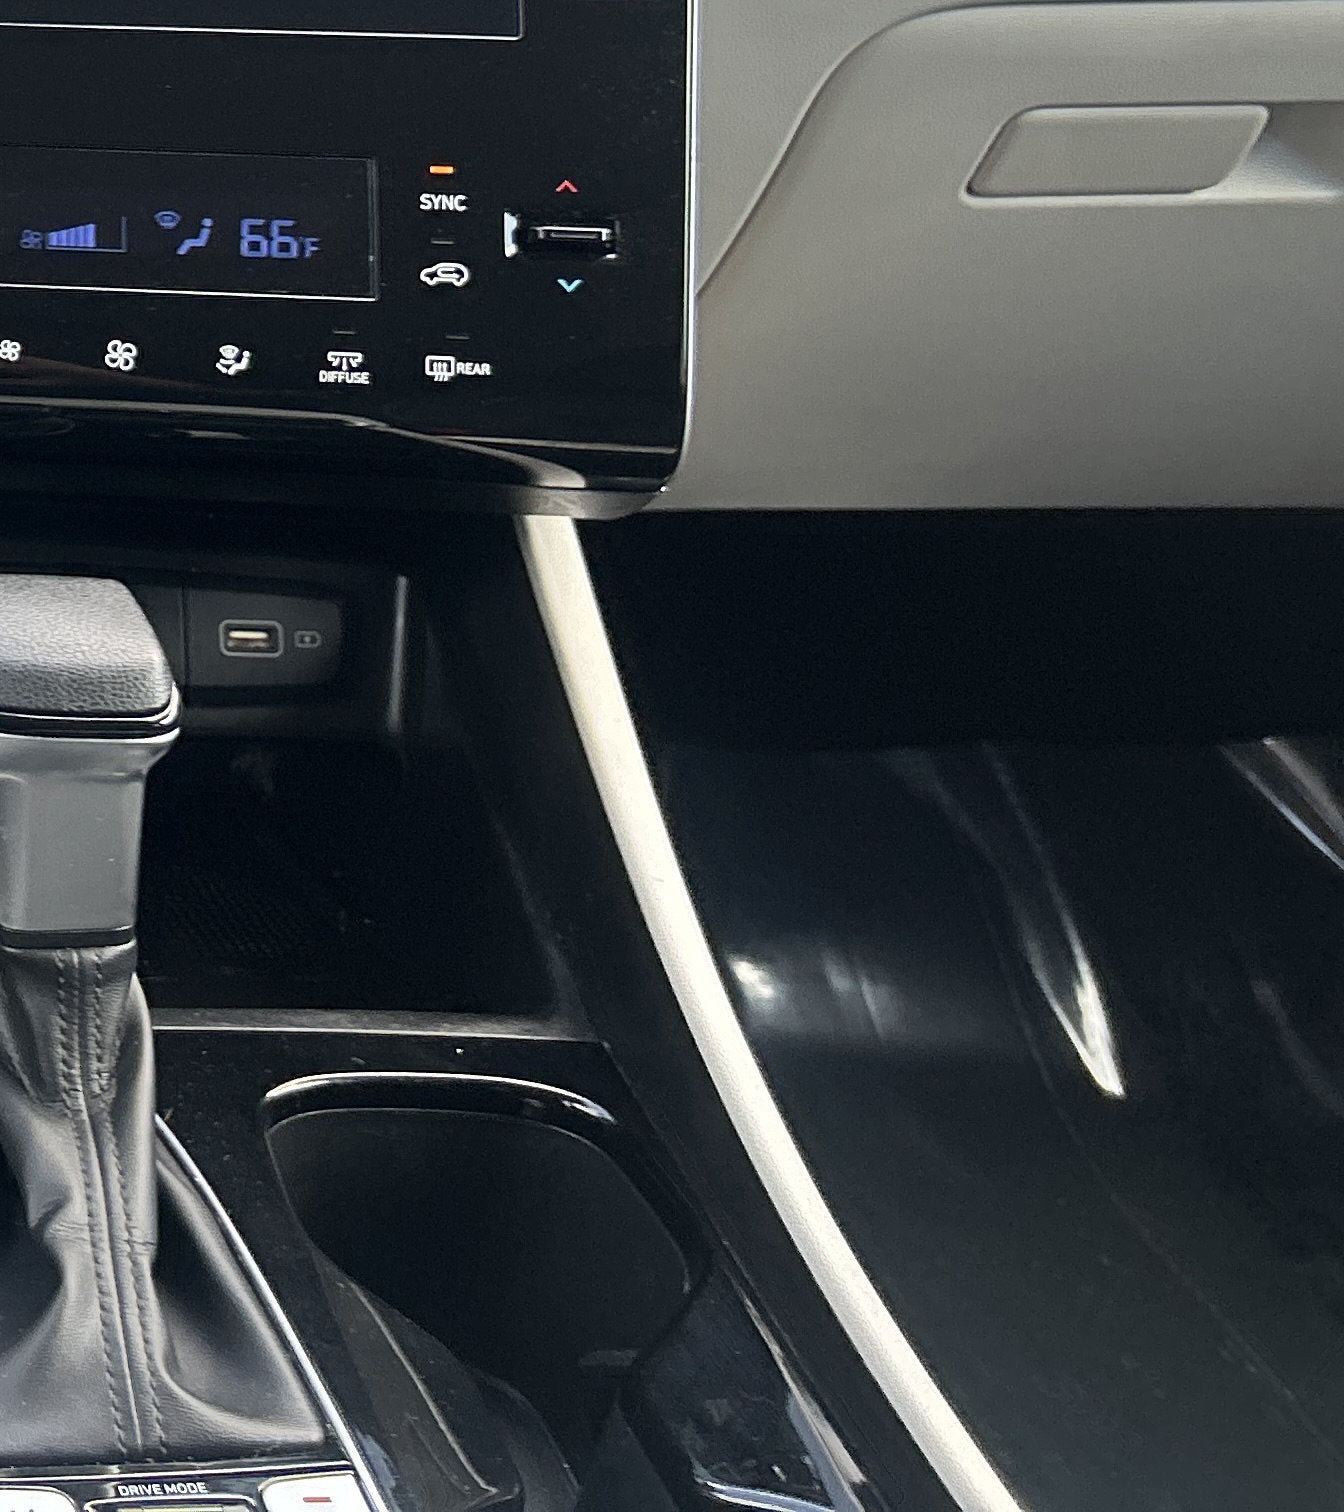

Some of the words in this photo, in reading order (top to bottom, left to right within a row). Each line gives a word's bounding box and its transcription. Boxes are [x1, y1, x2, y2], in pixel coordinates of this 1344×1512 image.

[420, 193, 467, 210] SYNC
[240, 218, 298, 258] 66
[456, 363, 491, 375] REAR
[319, 371, 370, 384] DIFFUSE
[117, 1483, 164, 1497] DRIVE
[163, 1481, 208, 1494] MODE
